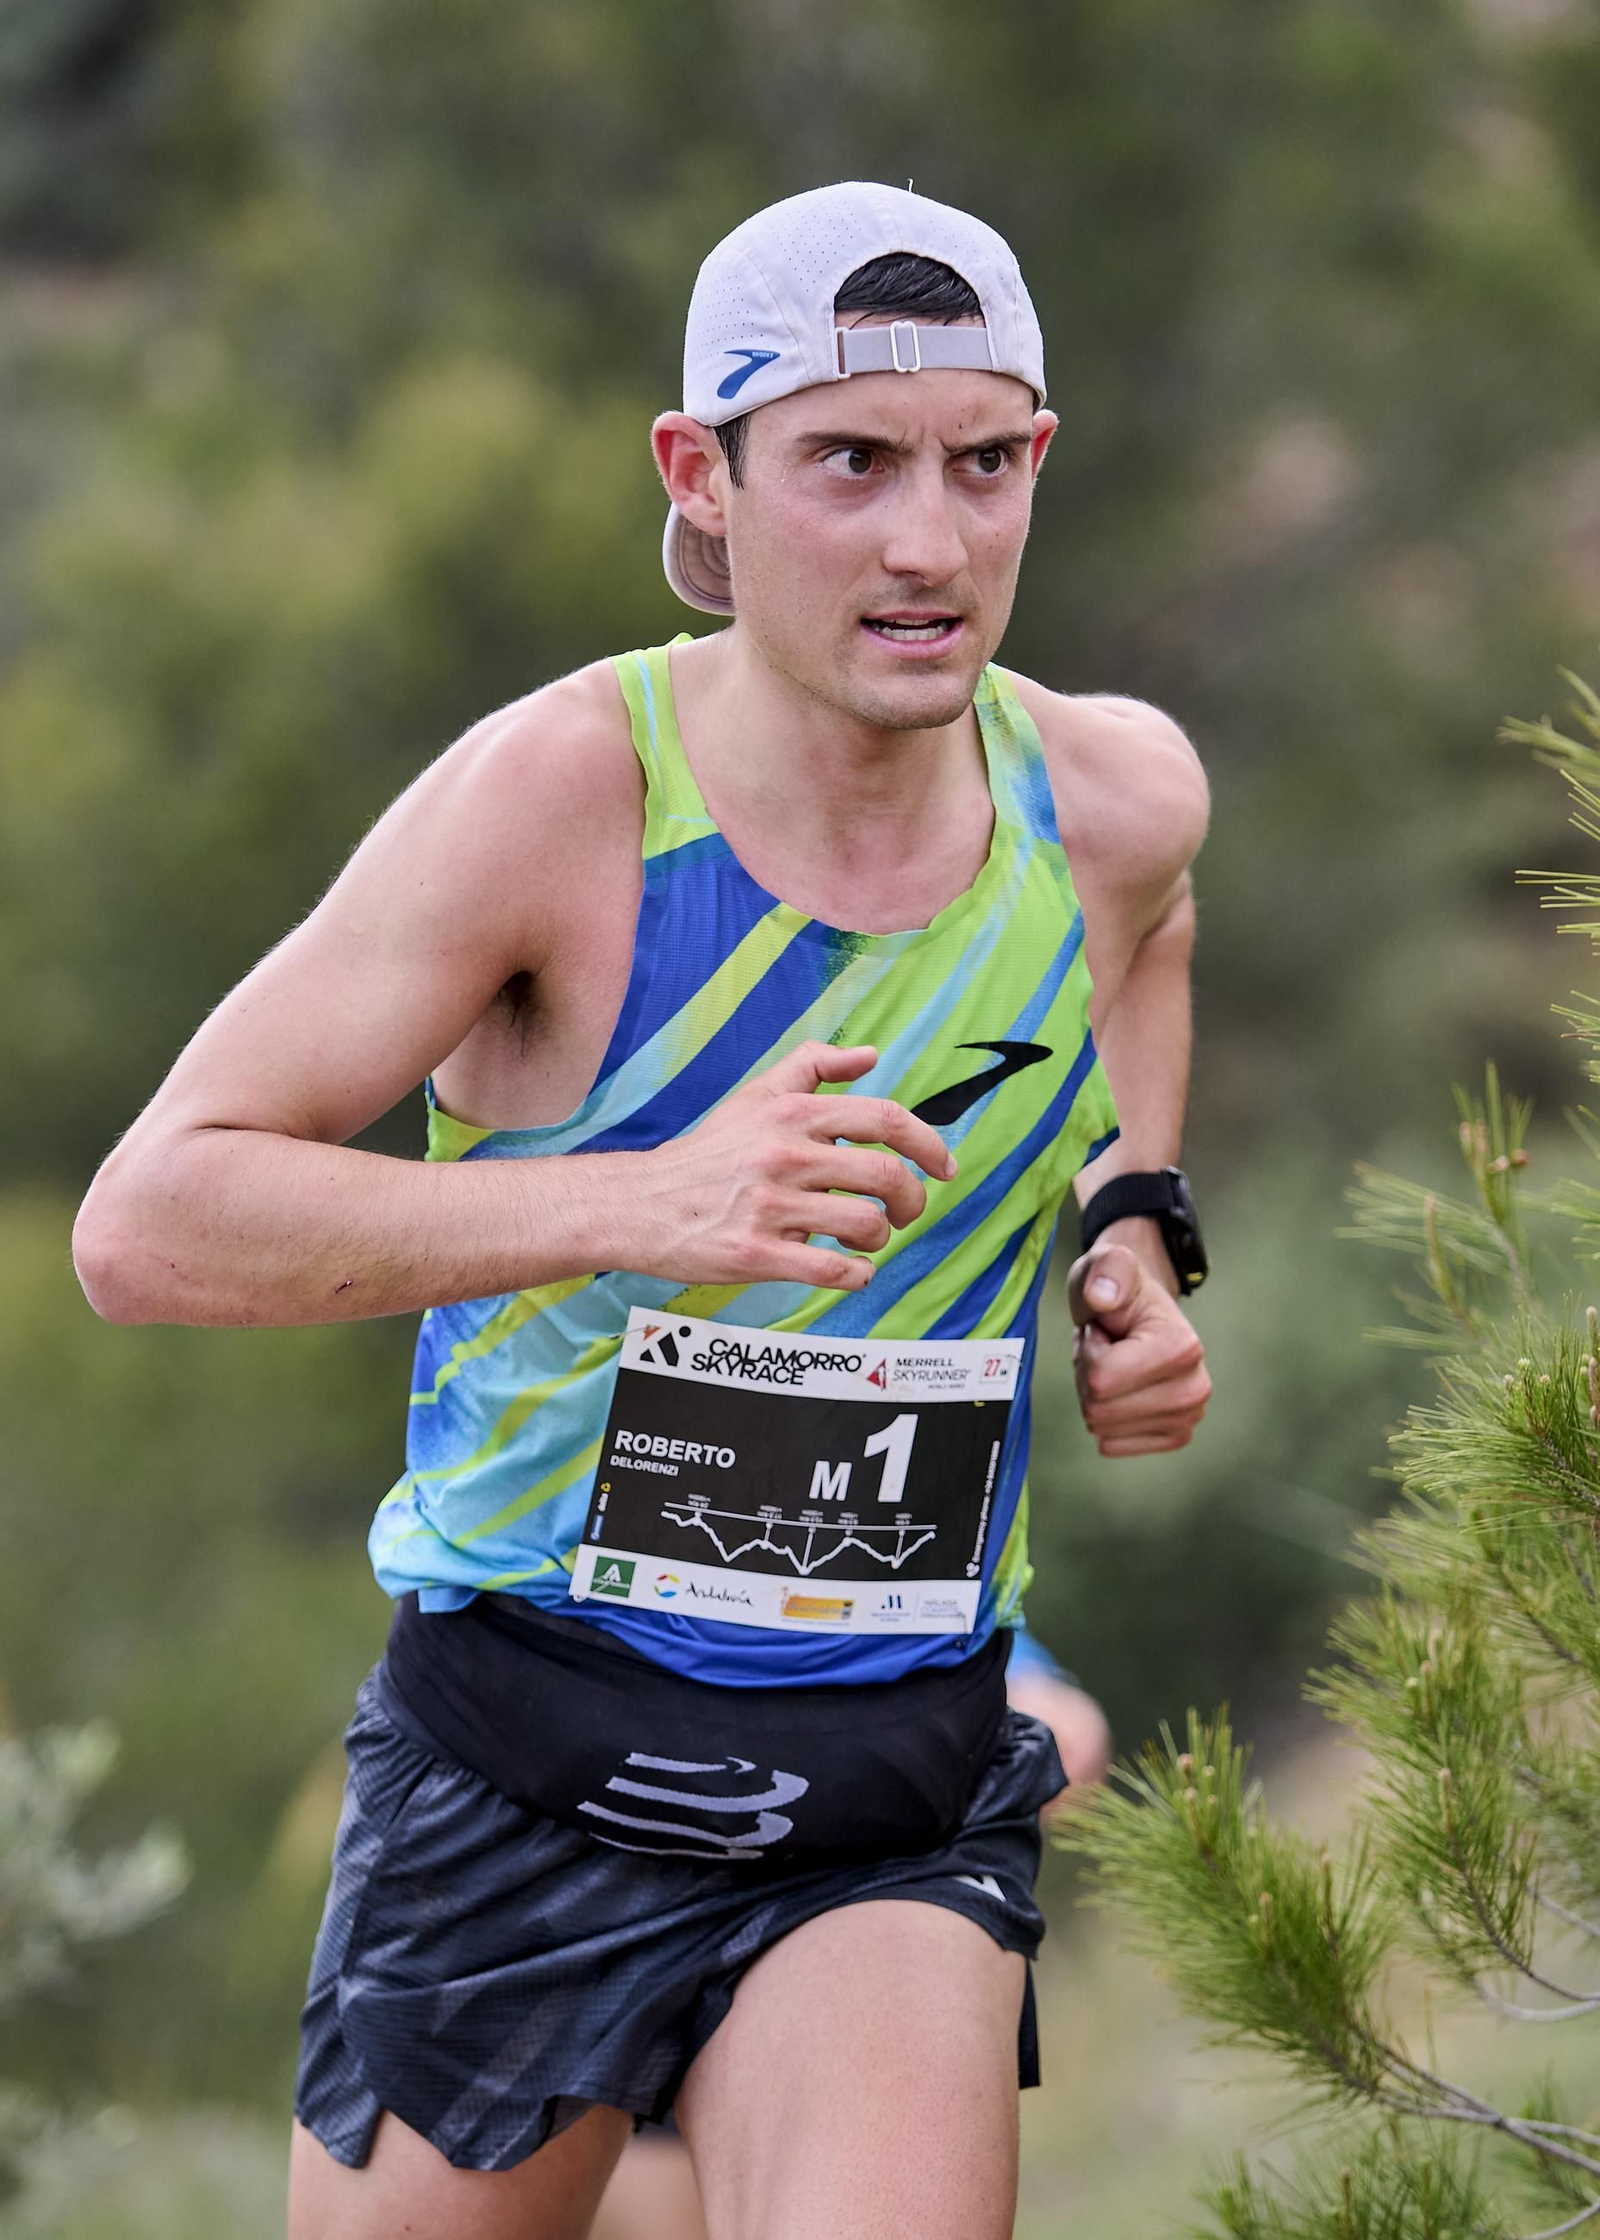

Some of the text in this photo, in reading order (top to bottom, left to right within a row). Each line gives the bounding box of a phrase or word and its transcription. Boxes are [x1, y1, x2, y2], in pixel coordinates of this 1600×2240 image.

[691, 1353, 805, 1386] SKYRACE
[709, 1338, 863, 1373] CALAMORRO
[895, 1357, 955, 1367] MERRELL
[984, 1358, 1001, 1377] 27
[893, 1368, 969, 1382] SKYRUNNER
[614, 1429, 736, 1469] ROBERTO
[808, 1460, 853, 1502] M
[863, 1413, 919, 1503] 1
[610, 1454, 680, 1477] DELORENZI
